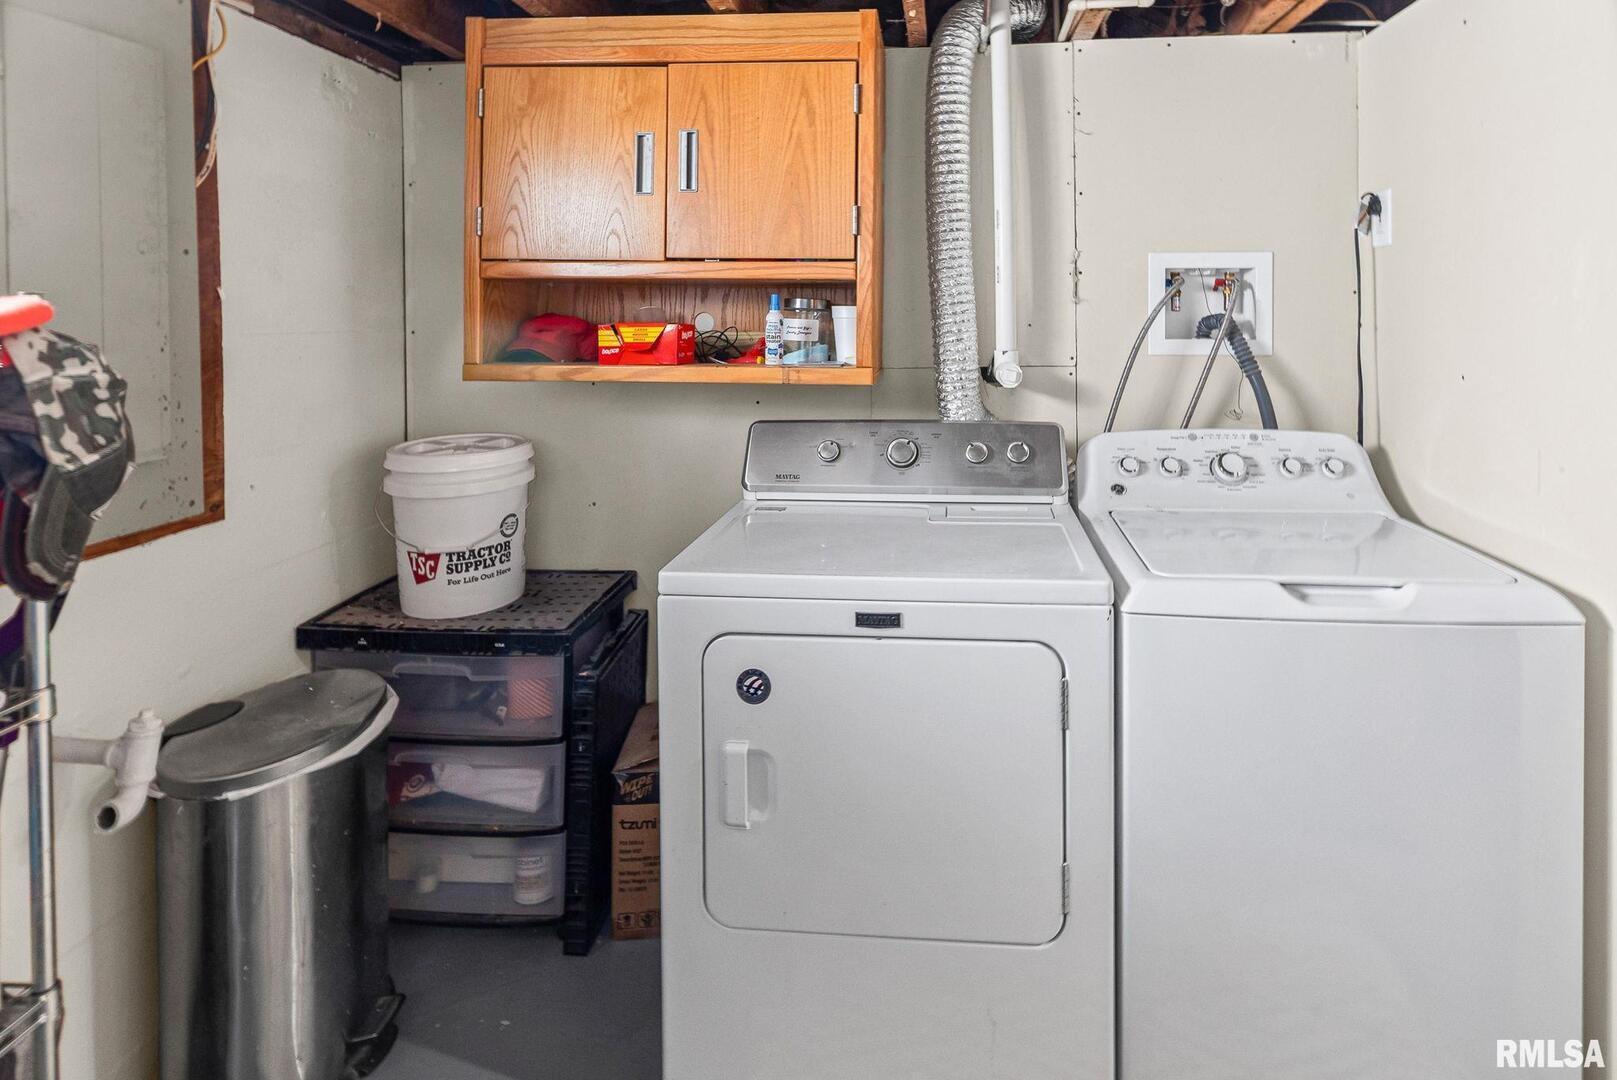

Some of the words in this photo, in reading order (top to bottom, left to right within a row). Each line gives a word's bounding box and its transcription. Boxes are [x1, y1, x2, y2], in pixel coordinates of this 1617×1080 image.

[445, 540, 512, 562] TRACTOR
[410, 552, 435, 580] TSC
[446, 554, 498, 575] SUPPLY
[447, 578, 461, 586] For
[463, 574, 479, 584] Life
[480, 570, 495, 581] Out
[496, 566, 511, 577] Here
[618, 817, 657, 830] tzumi
